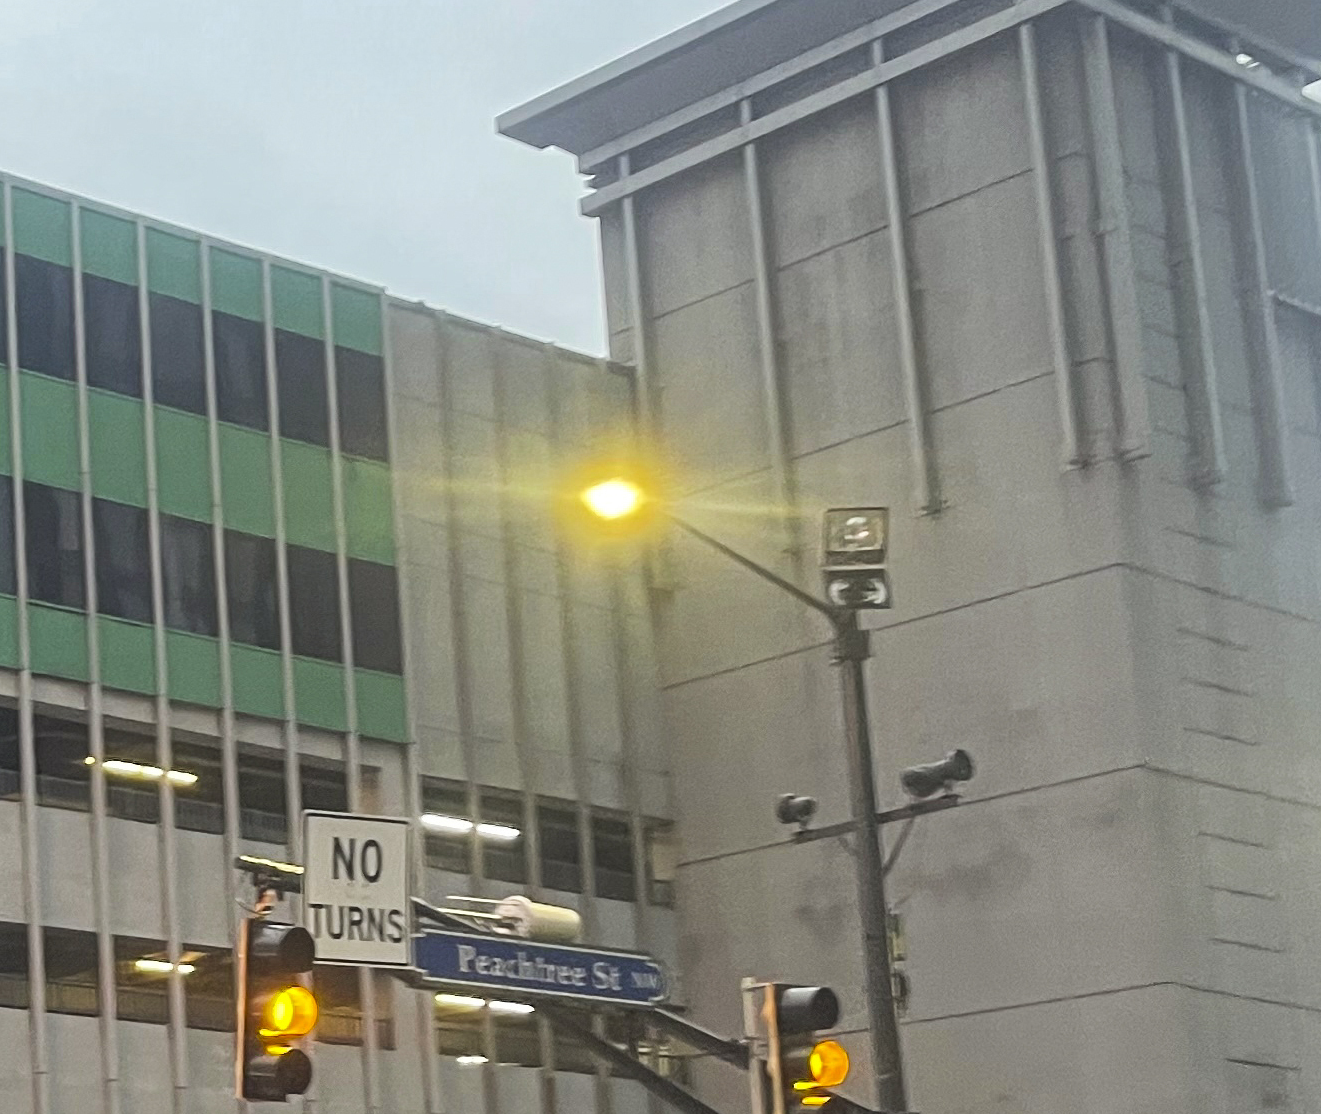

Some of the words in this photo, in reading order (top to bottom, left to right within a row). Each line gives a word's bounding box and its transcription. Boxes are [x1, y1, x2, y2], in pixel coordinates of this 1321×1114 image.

[332, 836, 382, 883] NO
[309, 903, 404, 943] TURNS
[457, 944, 587, 987] Peachtree
[591, 961, 622, 991] St
